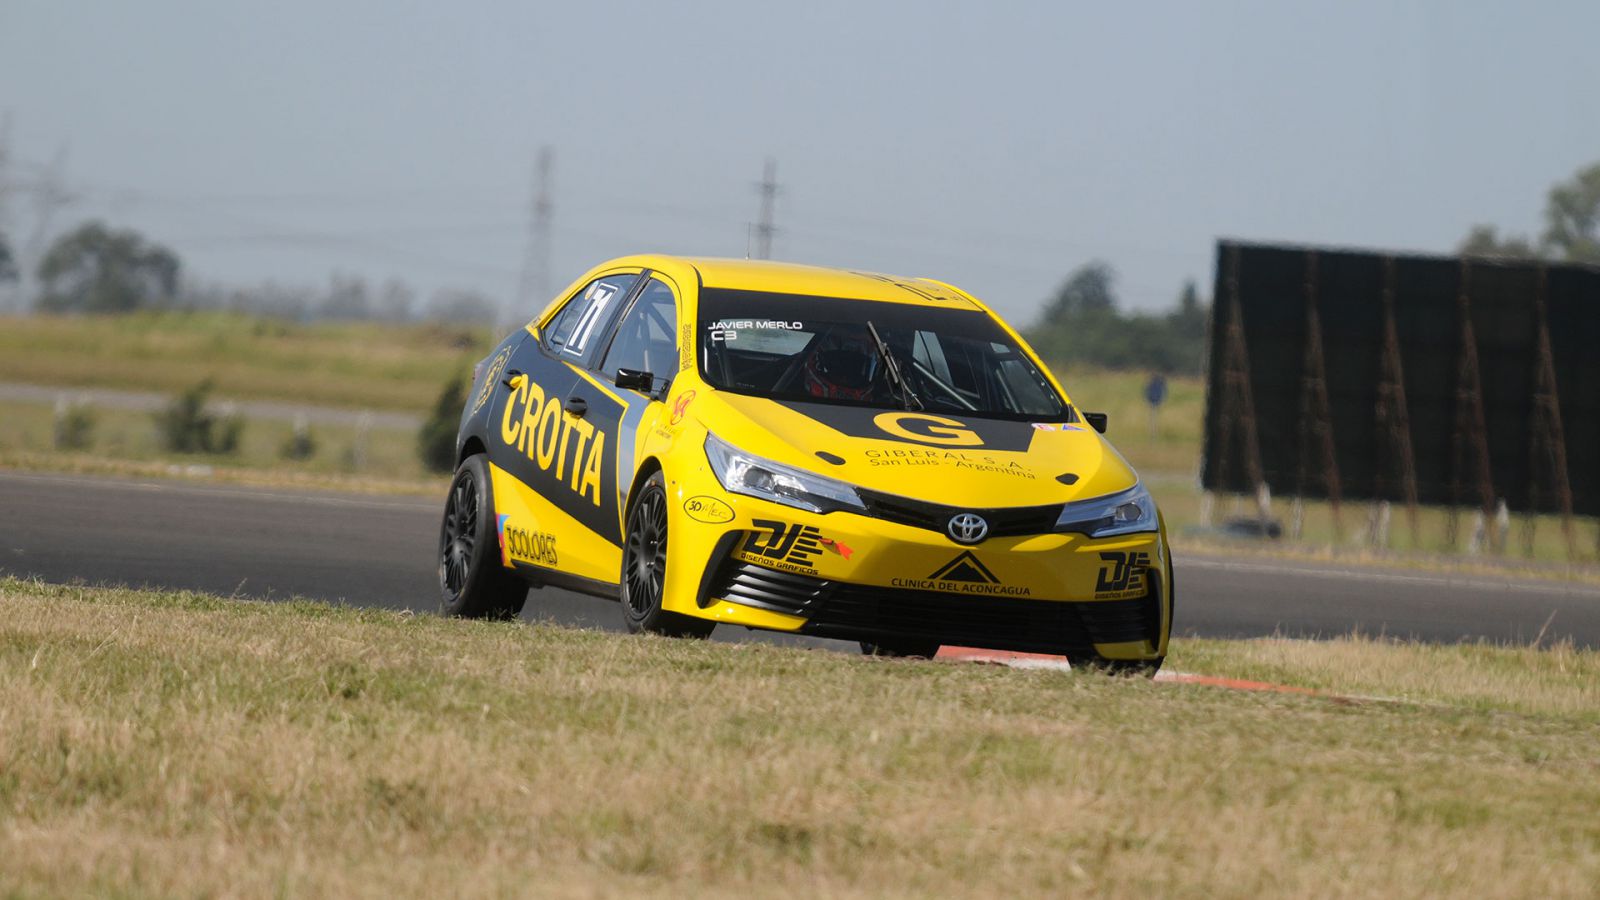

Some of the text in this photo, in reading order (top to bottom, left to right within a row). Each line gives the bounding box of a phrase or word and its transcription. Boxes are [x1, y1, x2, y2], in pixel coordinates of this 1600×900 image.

[707, 321, 803, 330] JAVIER MERLO
[711, 330, 737, 341] C3
[873, 412, 985, 446] G
[501, 373, 605, 507] CROTTA
[865, 450, 973, 462] GIBERAL
[870, 459, 901, 467] San
[906, 457, 939, 466] Luis
[956, 461, 1036, 480] Argentina
[891, 578, 1031, 595] CLINICA DEL ACONCAGUA
